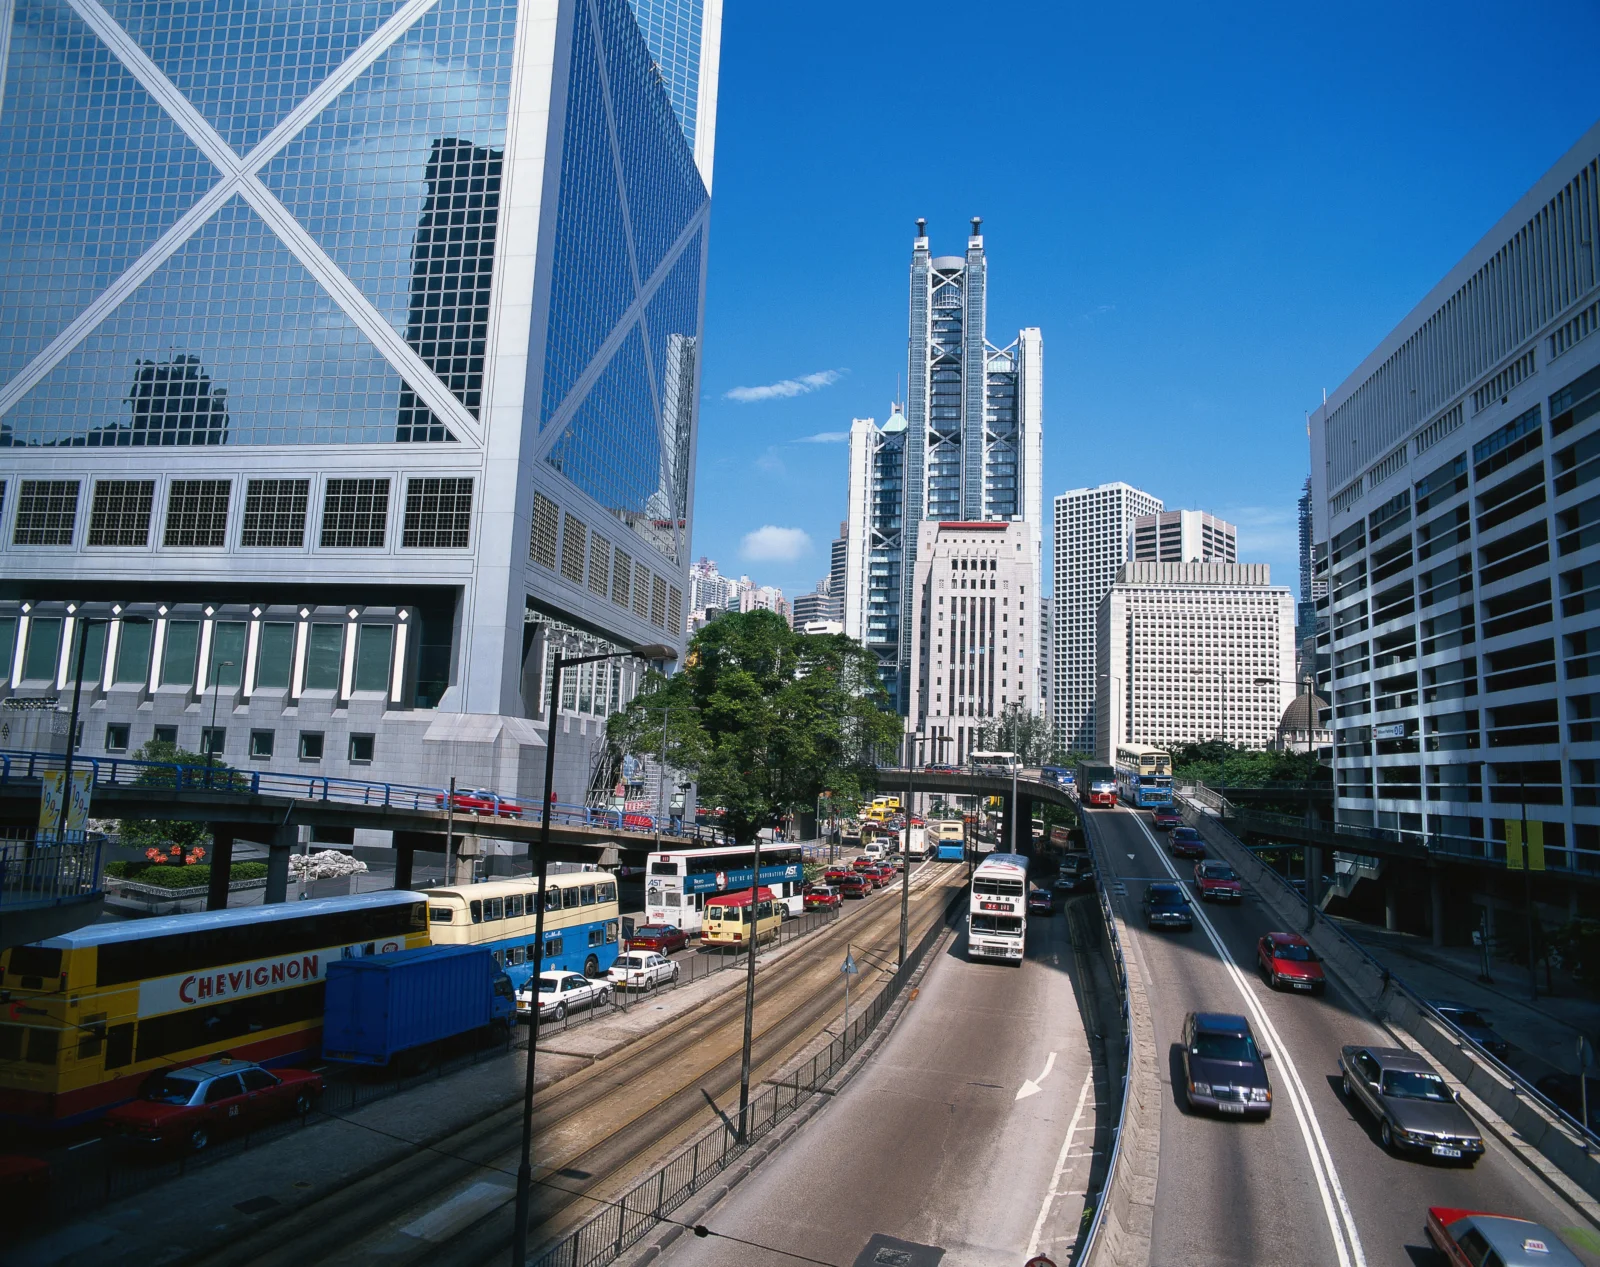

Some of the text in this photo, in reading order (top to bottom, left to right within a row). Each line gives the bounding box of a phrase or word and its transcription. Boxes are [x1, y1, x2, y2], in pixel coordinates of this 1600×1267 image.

[44, 785, 60, 827] 1997
[73, 784, 88, 825] 1997
[758, 871, 784, 879] NSPIRATION
[785, 866, 797, 875] AST
[179, 955, 318, 1004] CHEVIGNON
